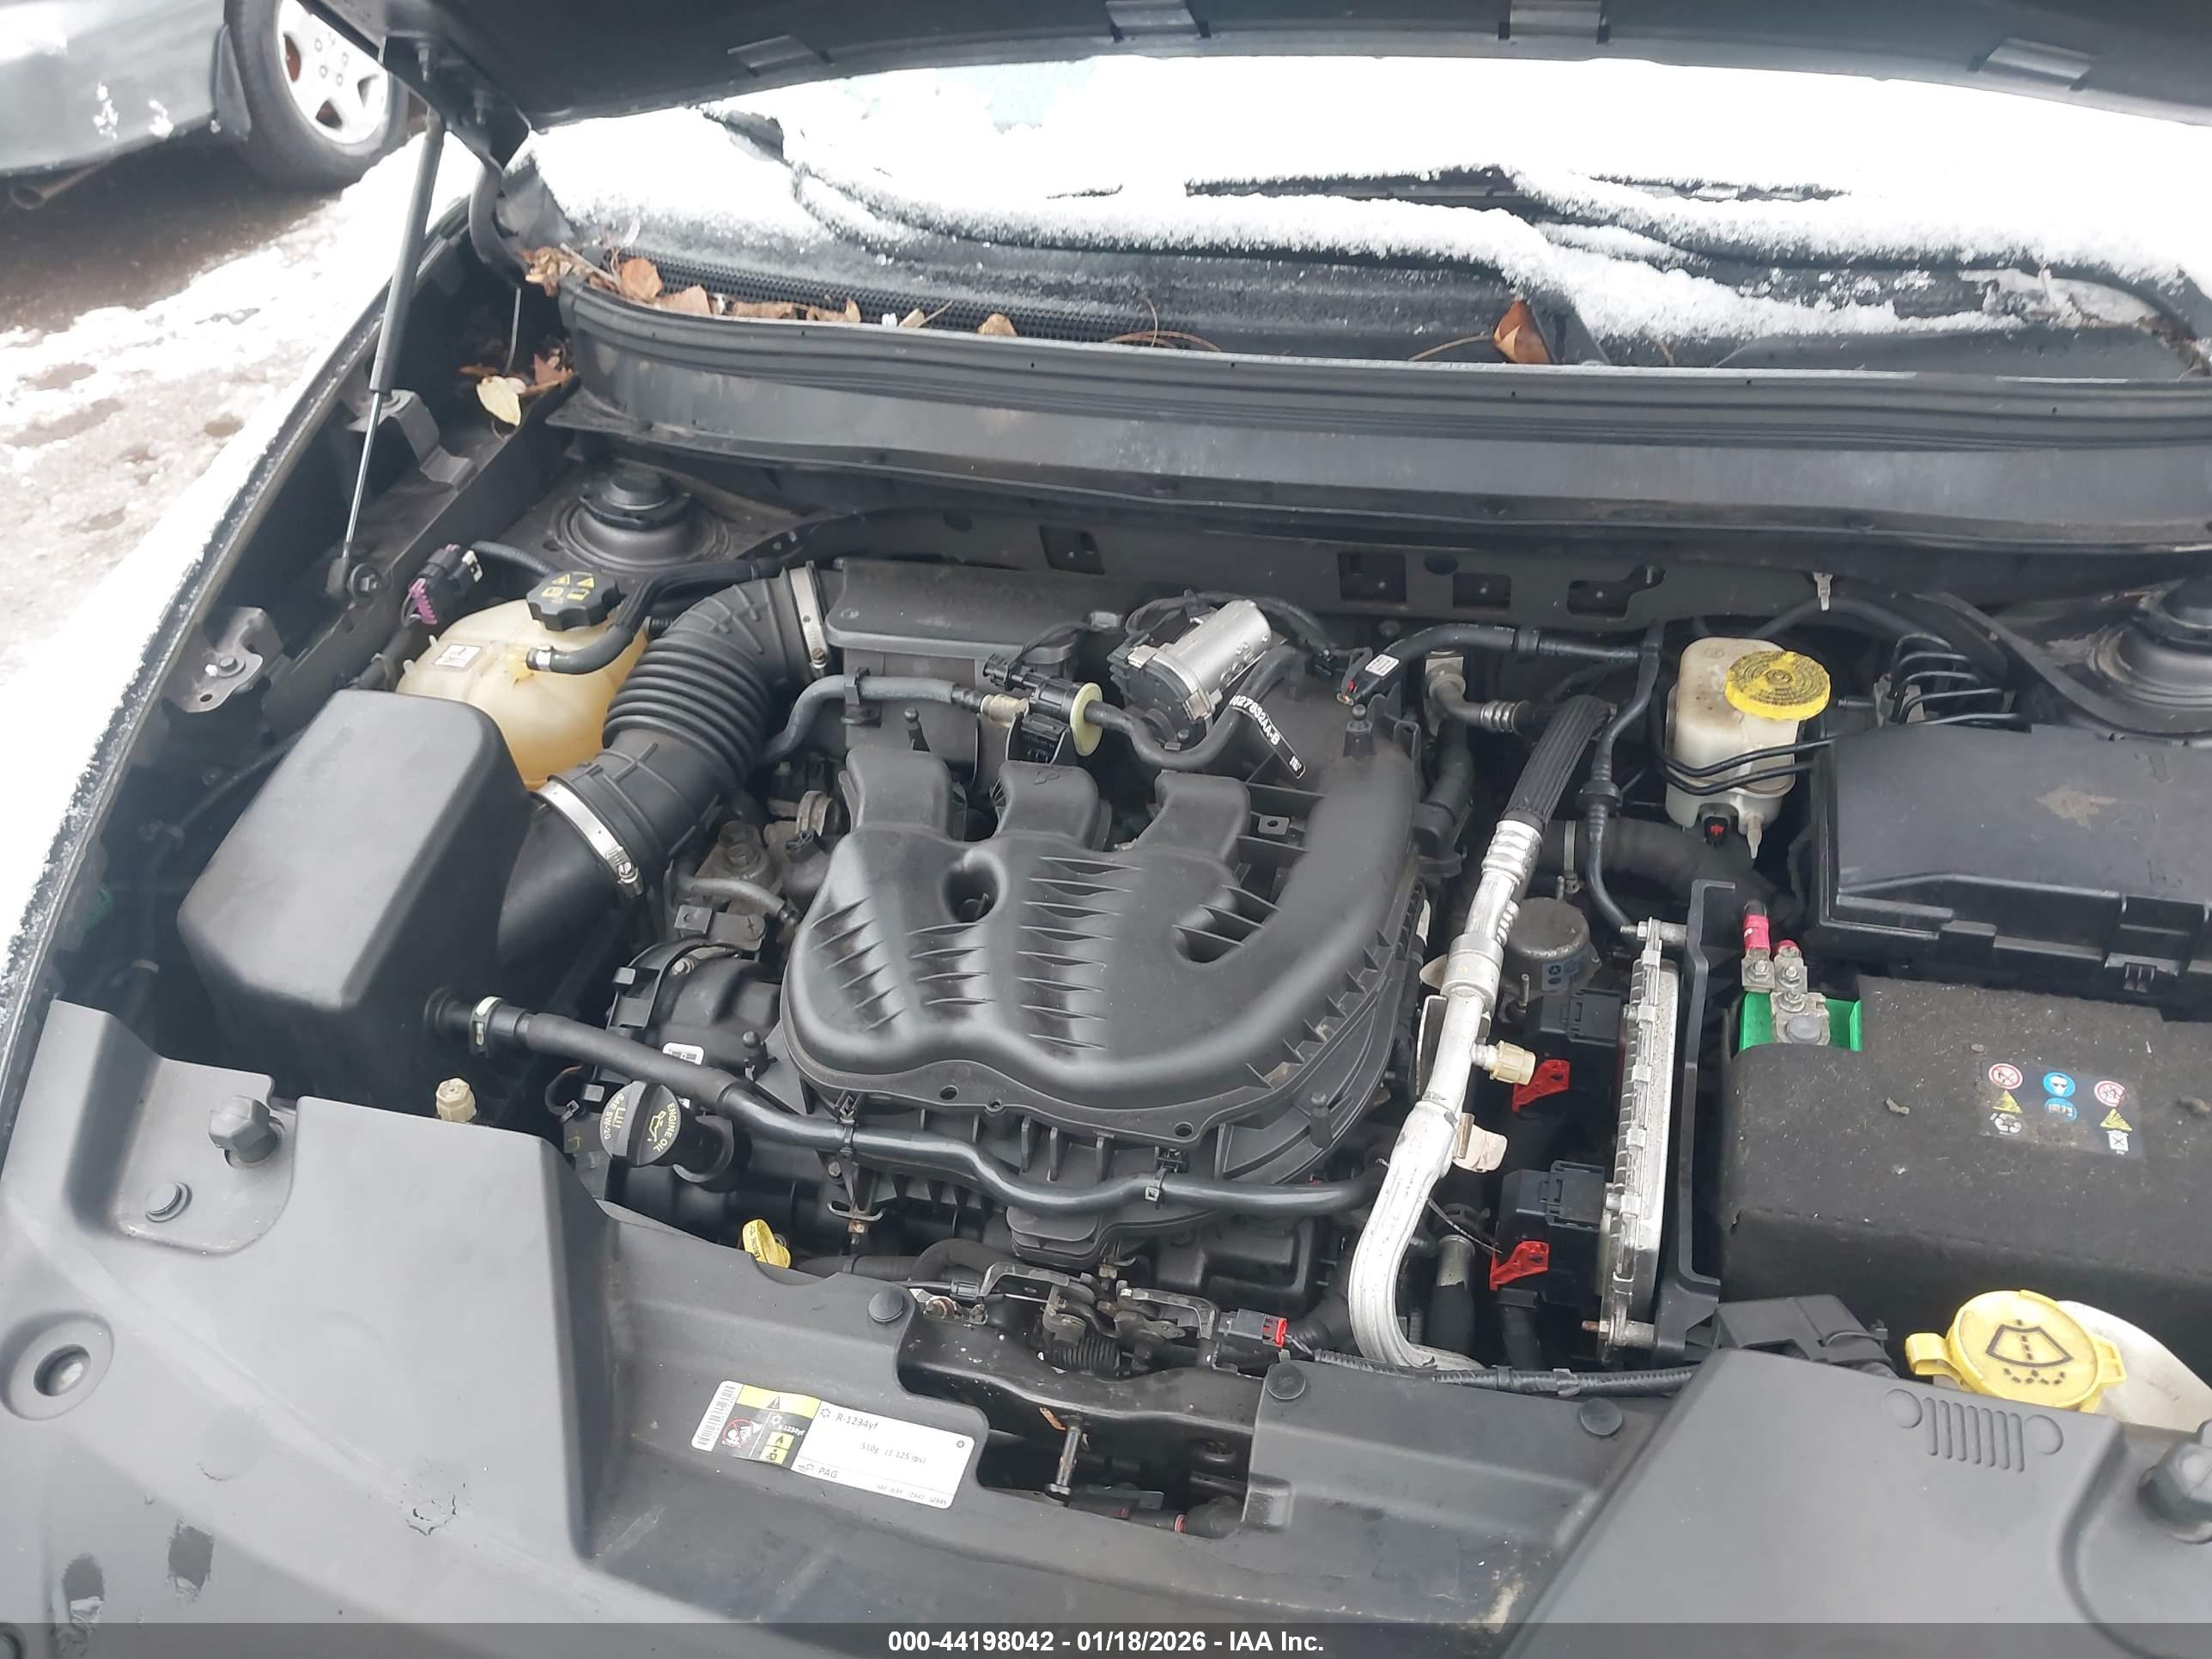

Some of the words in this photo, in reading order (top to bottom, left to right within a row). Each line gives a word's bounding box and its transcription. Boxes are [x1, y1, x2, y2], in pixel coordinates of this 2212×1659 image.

[609, 1093, 624, 1109] SAE
[665, 1103, 677, 1138] ENGINE
[653, 1138, 667, 1152] OIL
[836, 1413, 879, 1431] R-1234yf
[818, 1466, 838, 1479] PAG
